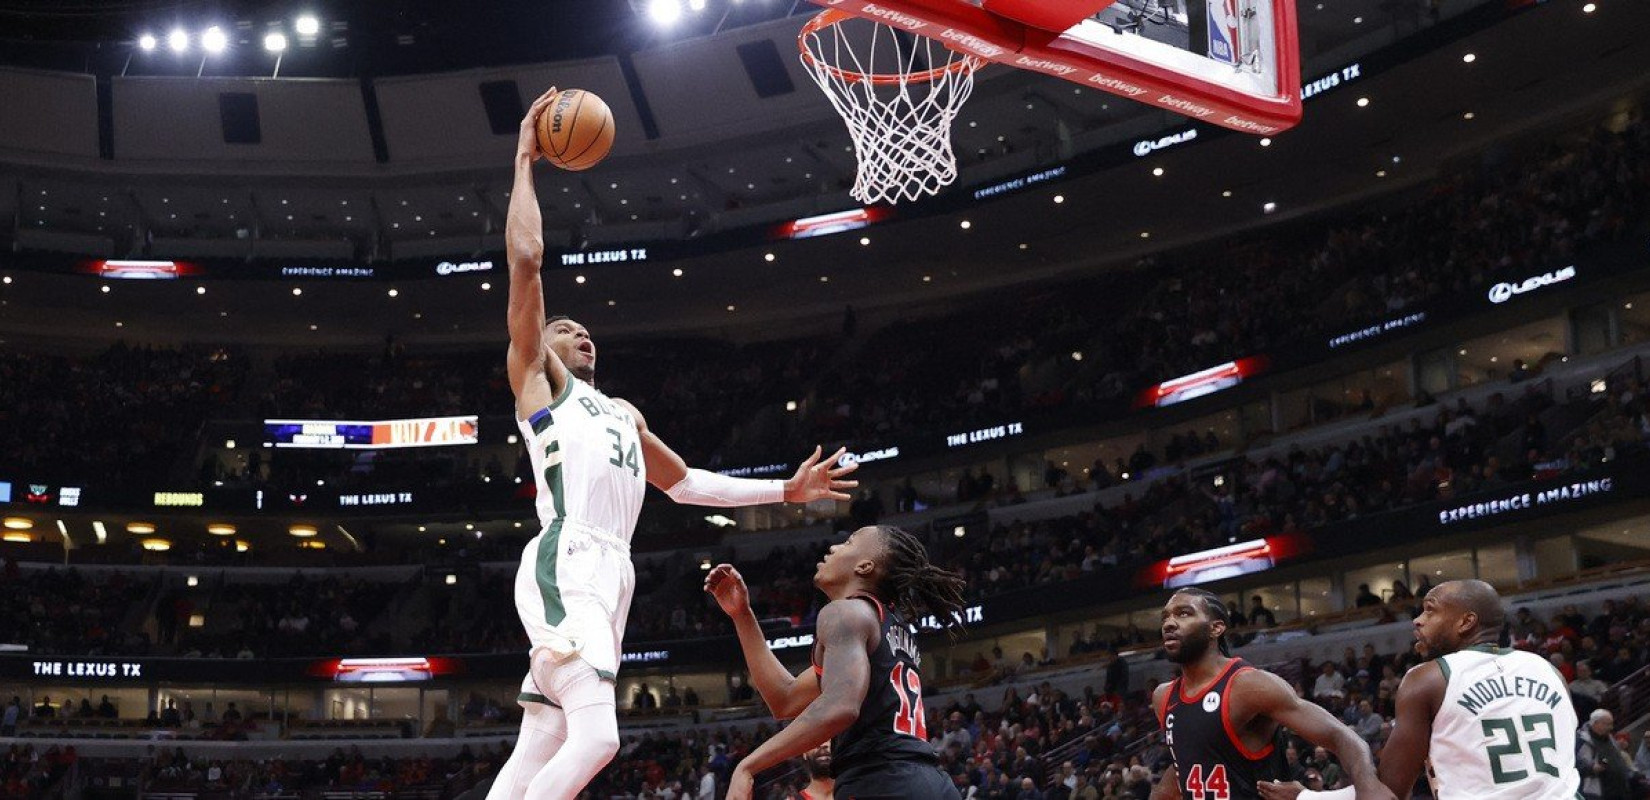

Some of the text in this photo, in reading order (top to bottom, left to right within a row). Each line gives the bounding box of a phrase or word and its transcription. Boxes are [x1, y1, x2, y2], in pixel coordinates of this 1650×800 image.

[861, 3, 928, 30] betway
[940, 28, 1003, 56] betway
[1016, 56, 1077, 75] betway
[1342, 63, 1360, 81] TX
[1088, 73, 1147, 96] betway
[1158, 94, 1215, 118] betway
[1224, 115, 1278, 134] betway
[561, 249, 647, 265] THE LEXUS TX
[1511, 265, 1576, 295] LEXUS
[946, 421, 1023, 447] THE LEXUS TX
[605, 427, 640, 478] 34
[339, 493, 413, 506] THE LEXUS TX
[1439, 476, 1612, 525] EXPERIENCE AMAZING
[965, 605, 984, 623] TX
[33, 661, 141, 677] THE LEXUS TX
[889, 660, 928, 742] 12
[1457, 676, 1562, 716] MIDDLETON
[1481, 712, 1560, 784] 22
[1186, 764, 1230, 800] 44
